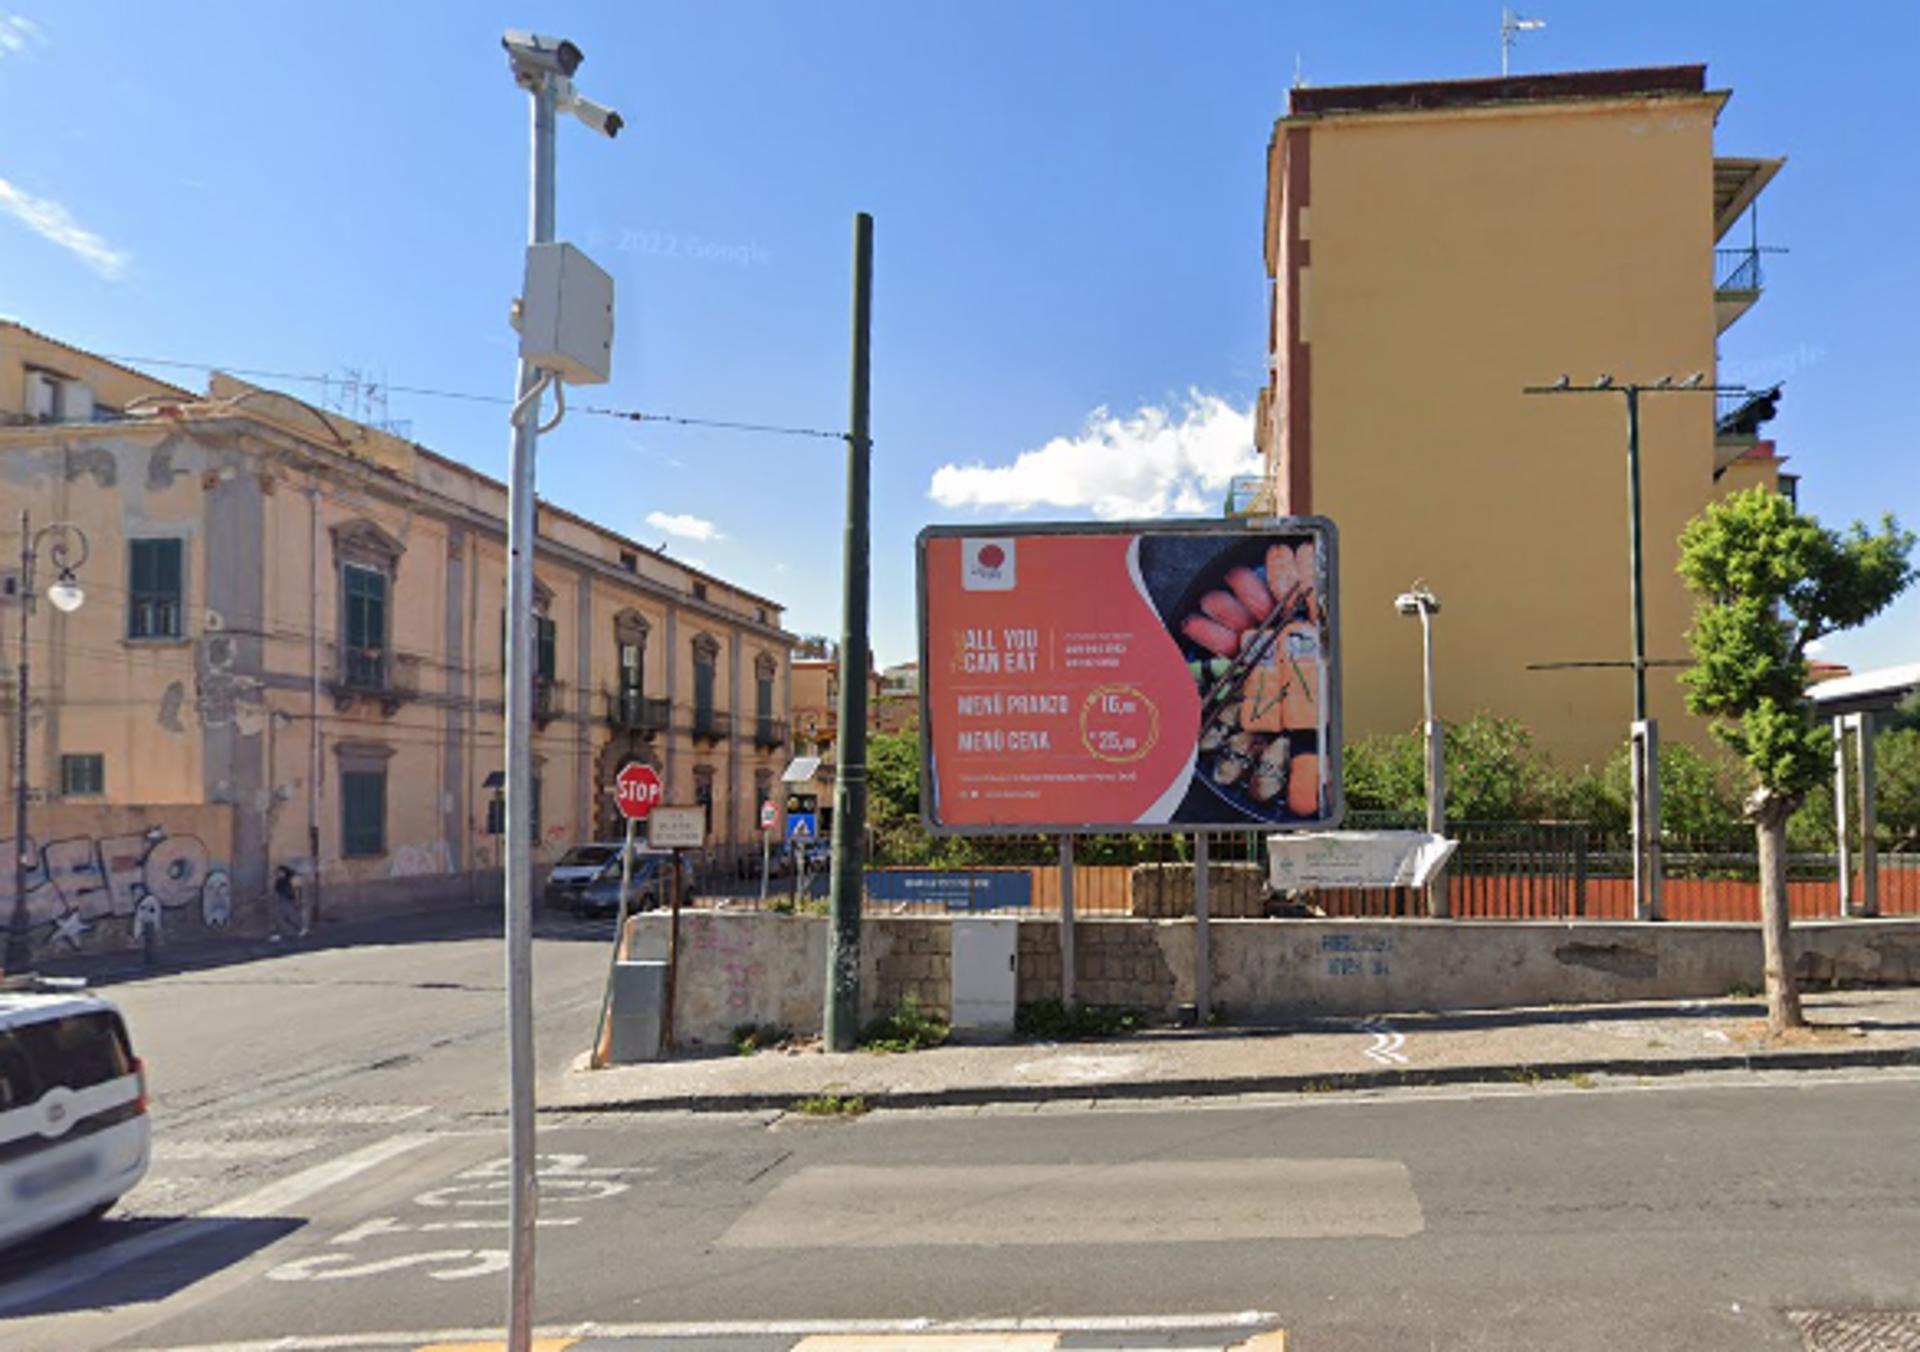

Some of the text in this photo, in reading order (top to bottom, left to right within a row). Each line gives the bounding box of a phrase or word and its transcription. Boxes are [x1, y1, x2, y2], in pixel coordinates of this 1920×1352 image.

[964, 627, 997, 650] ALL
[1003, 627, 1038, 650] YOU
[964, 652, 999, 674] CAN
[1005, 651, 1038, 673] EAT
[1007, 730, 1051, 751] CENA
[618, 780, 658, 803] STOP
